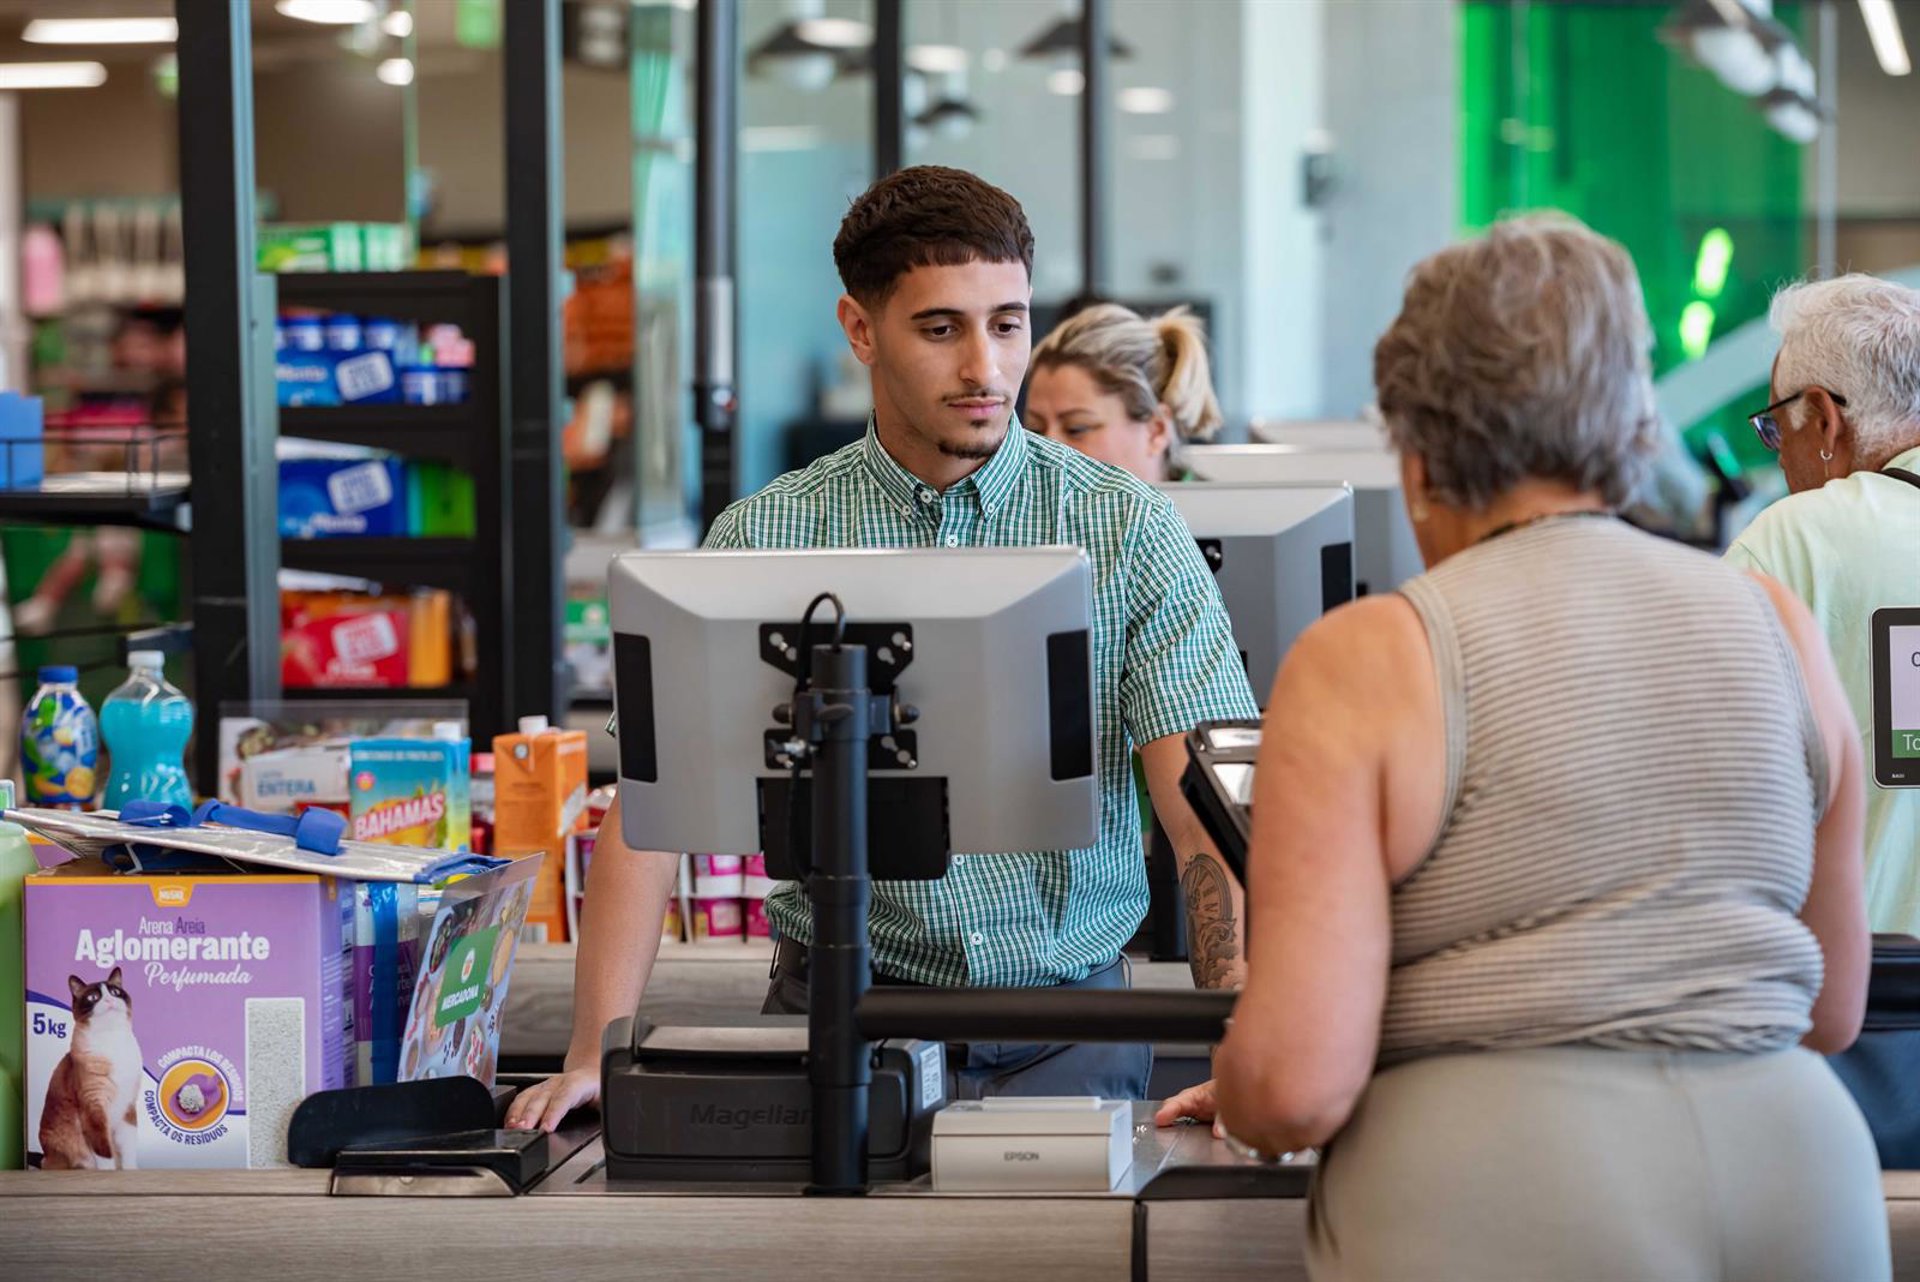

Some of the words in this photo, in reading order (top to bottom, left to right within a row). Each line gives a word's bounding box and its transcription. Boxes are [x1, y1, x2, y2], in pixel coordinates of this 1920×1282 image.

[354, 792, 445, 841] BAHAMAS
[138, 916, 174, 934] Arena
[175, 916, 205, 934] Areia
[75, 929, 269, 968] Aglomerante
[144, 962, 252, 992] Perfumada
[33, 1012, 46, 1035] 5
[48, 1018, 67, 1038] kg
[157, 1045, 204, 1068] COMPACTA
[144, 1090, 171, 1136] COMPACTA
[171, 1131, 183, 1143] OS
[184, 1124, 228, 1145] RESÍDUOS
[1004, 1151, 1039, 1161] EPSON
